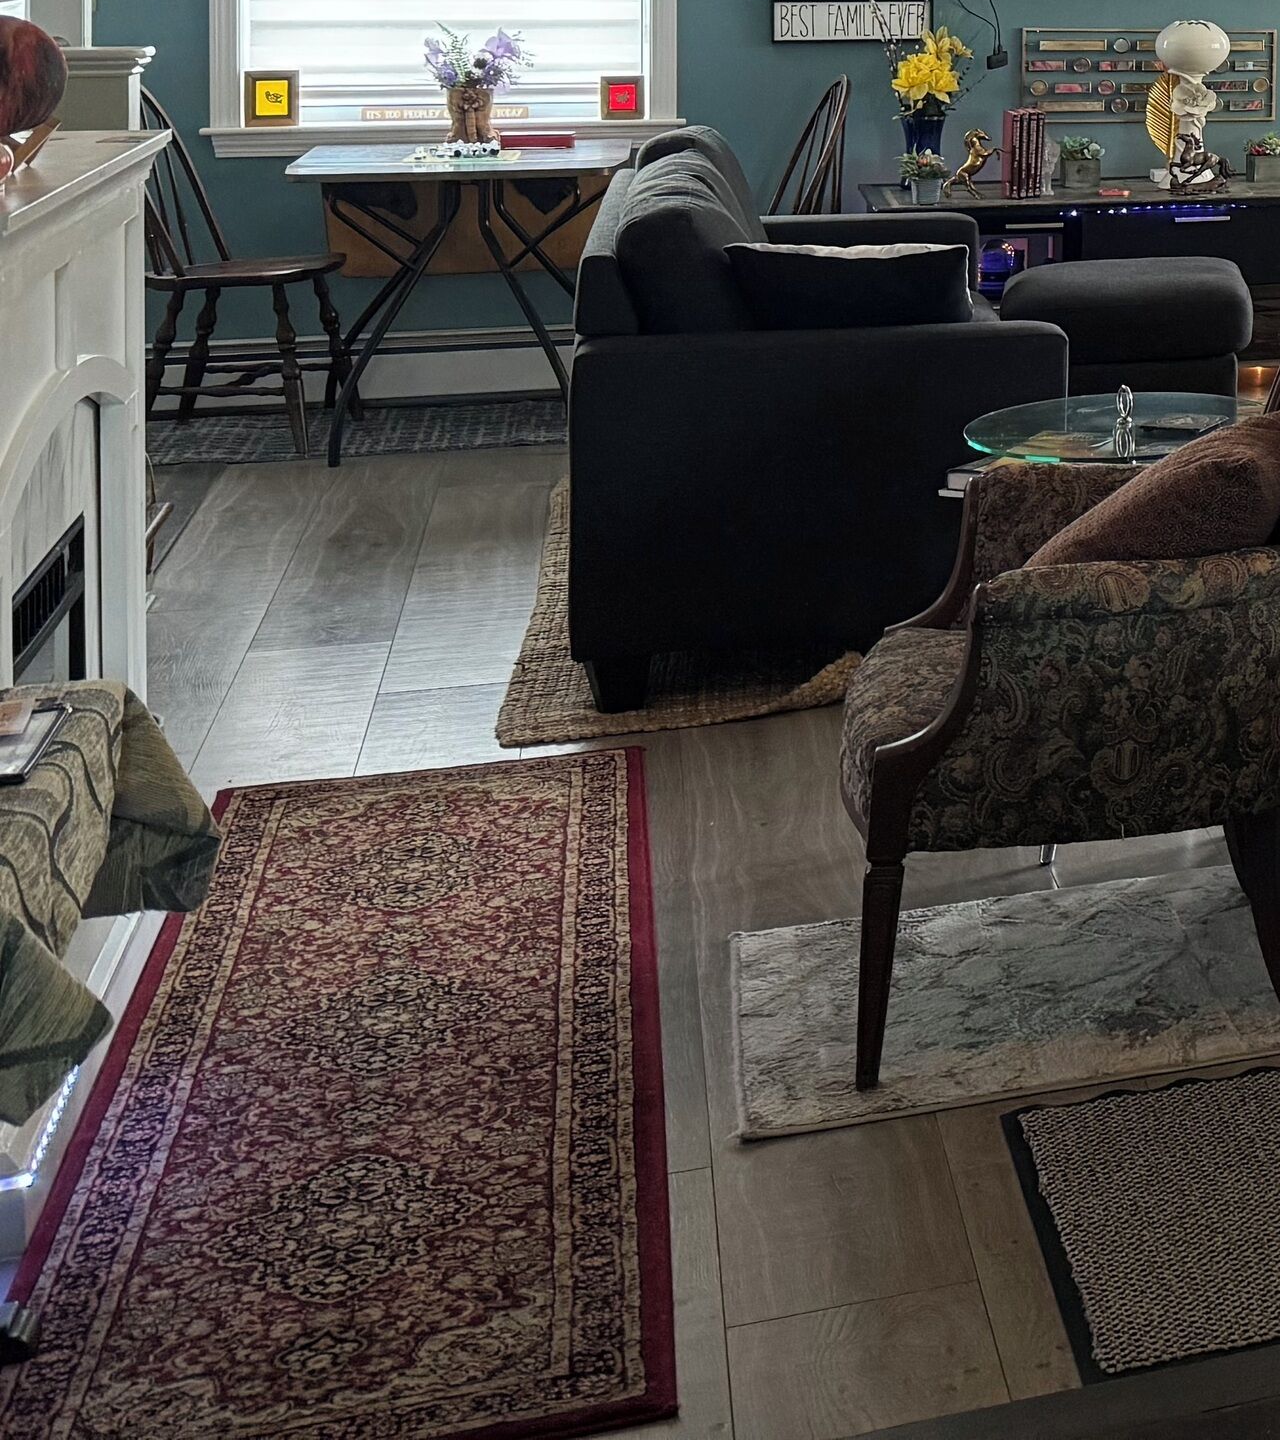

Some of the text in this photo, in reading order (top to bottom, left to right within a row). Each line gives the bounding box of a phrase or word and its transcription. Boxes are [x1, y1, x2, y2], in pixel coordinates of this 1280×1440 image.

[780, 4, 817, 38] BEST
[889, 3, 925, 37] EVER
[385, 109, 401, 120] TOO
